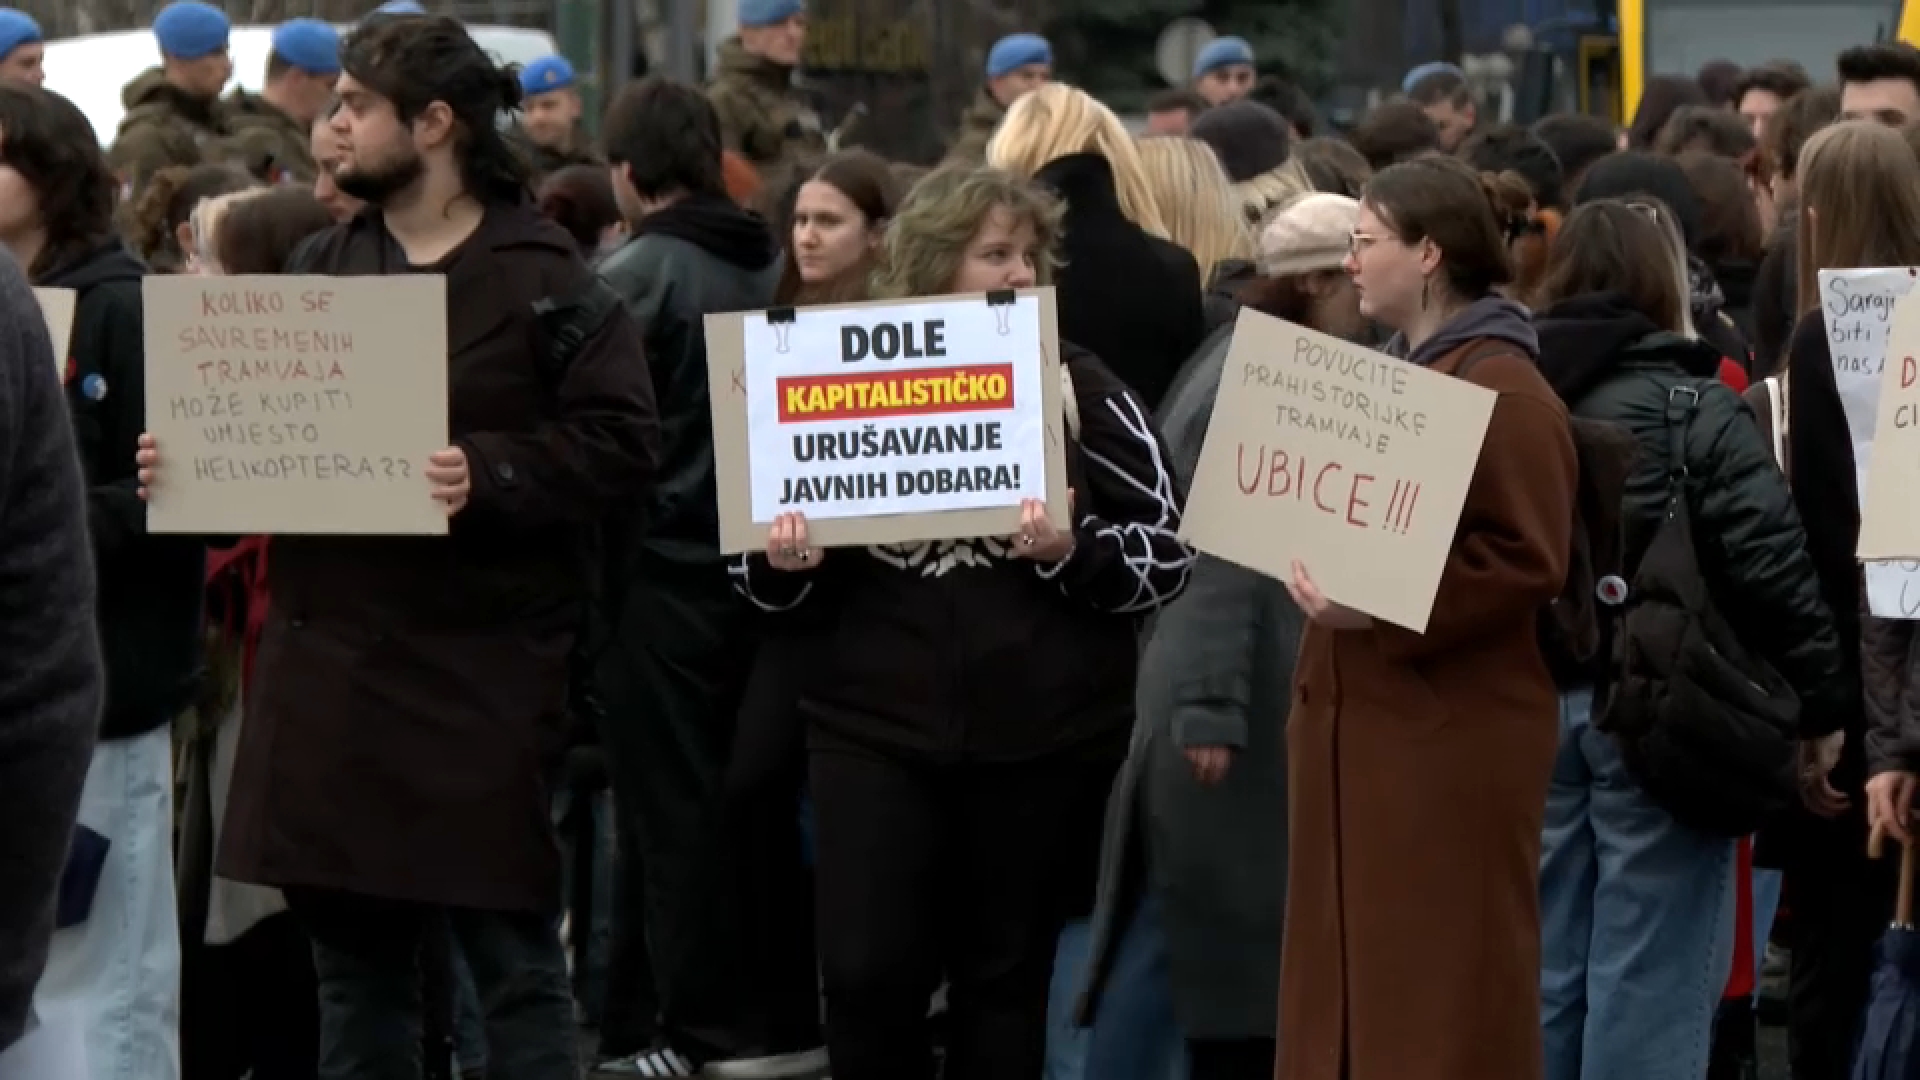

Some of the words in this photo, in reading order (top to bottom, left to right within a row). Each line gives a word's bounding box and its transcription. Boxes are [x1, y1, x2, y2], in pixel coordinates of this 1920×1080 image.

[201, 290, 284, 316] KOLIKO
[300, 290, 335, 312] SE
[178, 325, 353, 353] SAVREMENIH
[840, 319, 947, 363] DOLE
[197, 360, 345, 386] TRAMVAJA
[1293, 337, 1410, 395] POVUCITE
[259, 389, 353, 414] KUPITI
[786, 371, 1007, 414] KAPITALISTIČKO
[1243, 363, 1427, 436] PRAHISTORIJKE
[203, 422, 319, 444] UMJESTO
[793, 422, 1003, 462] URUŠAVANJE
[1276, 405, 1390, 454] TRAMVAJE
[779, 471, 888, 504] JAVNIH
[895, 464, 1021, 497] DOBARA!
